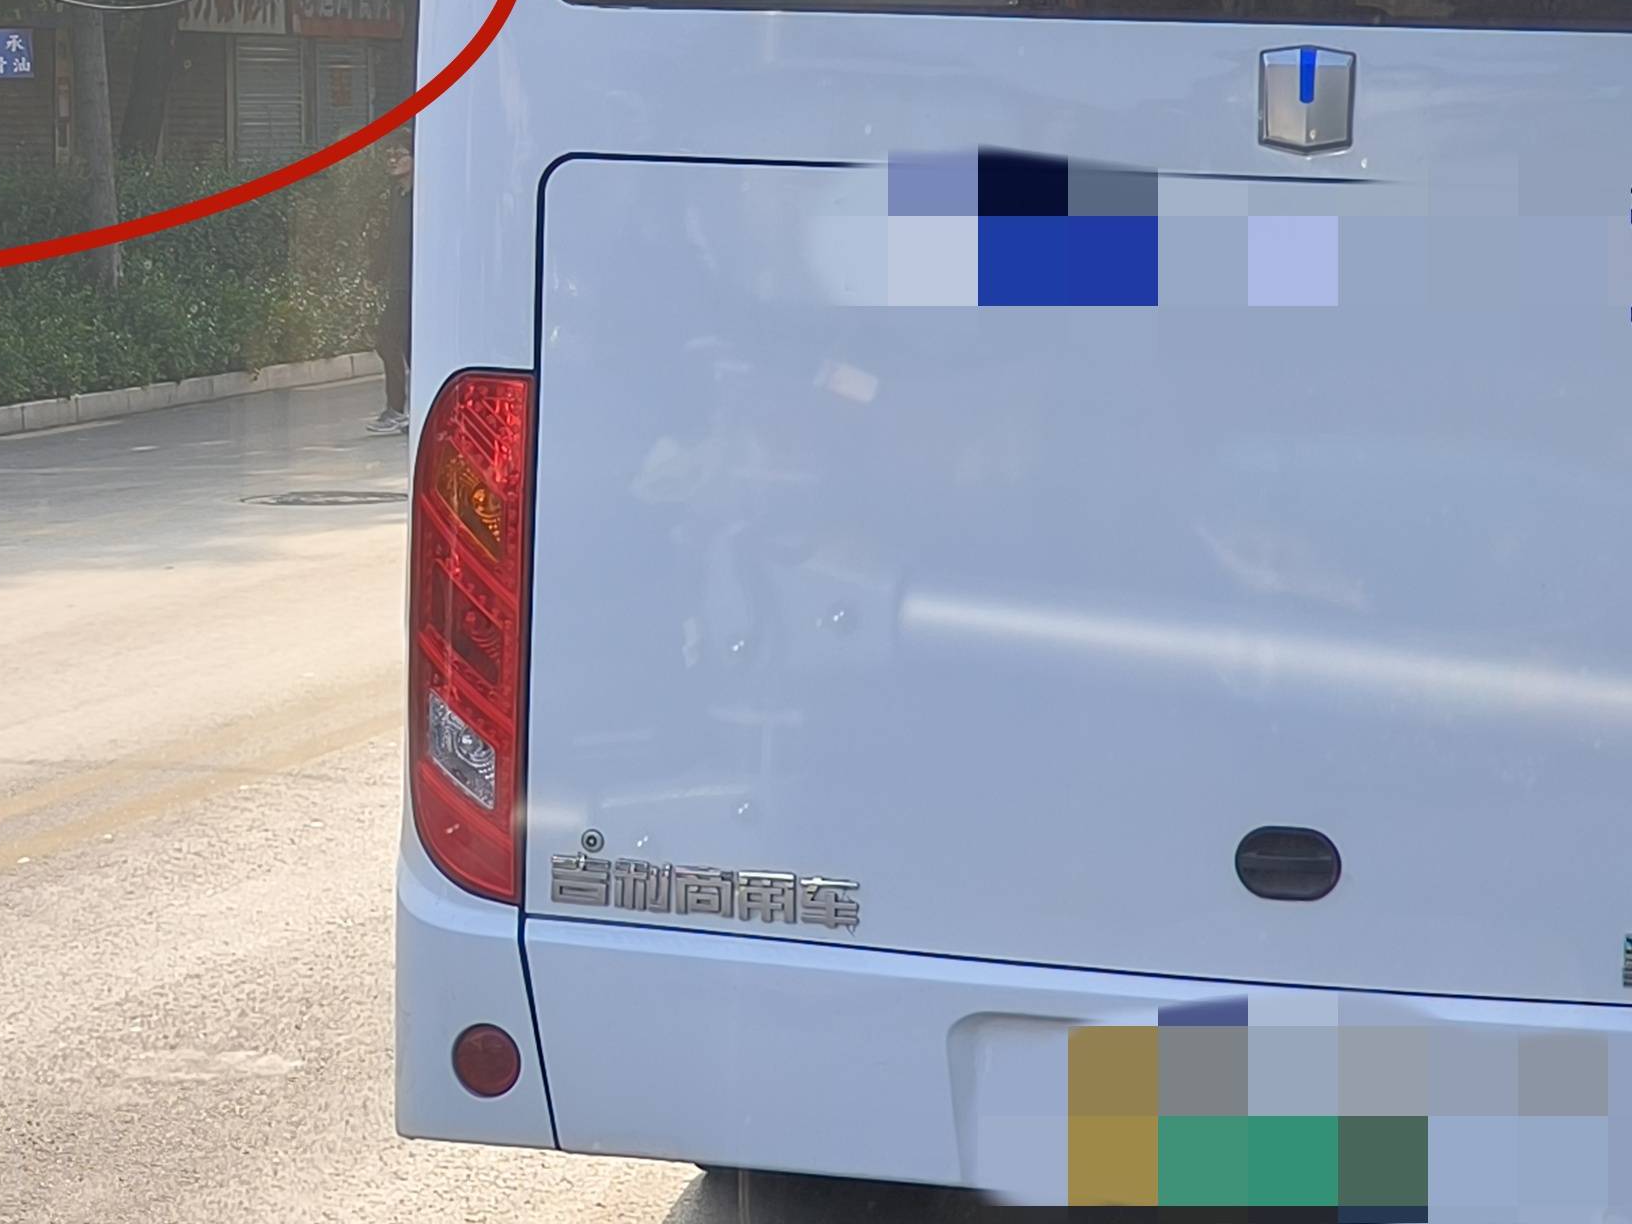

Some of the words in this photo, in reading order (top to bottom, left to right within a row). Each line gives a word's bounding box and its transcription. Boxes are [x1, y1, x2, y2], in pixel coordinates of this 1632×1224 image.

[550, 852, 860, 929] 吉利商用车
